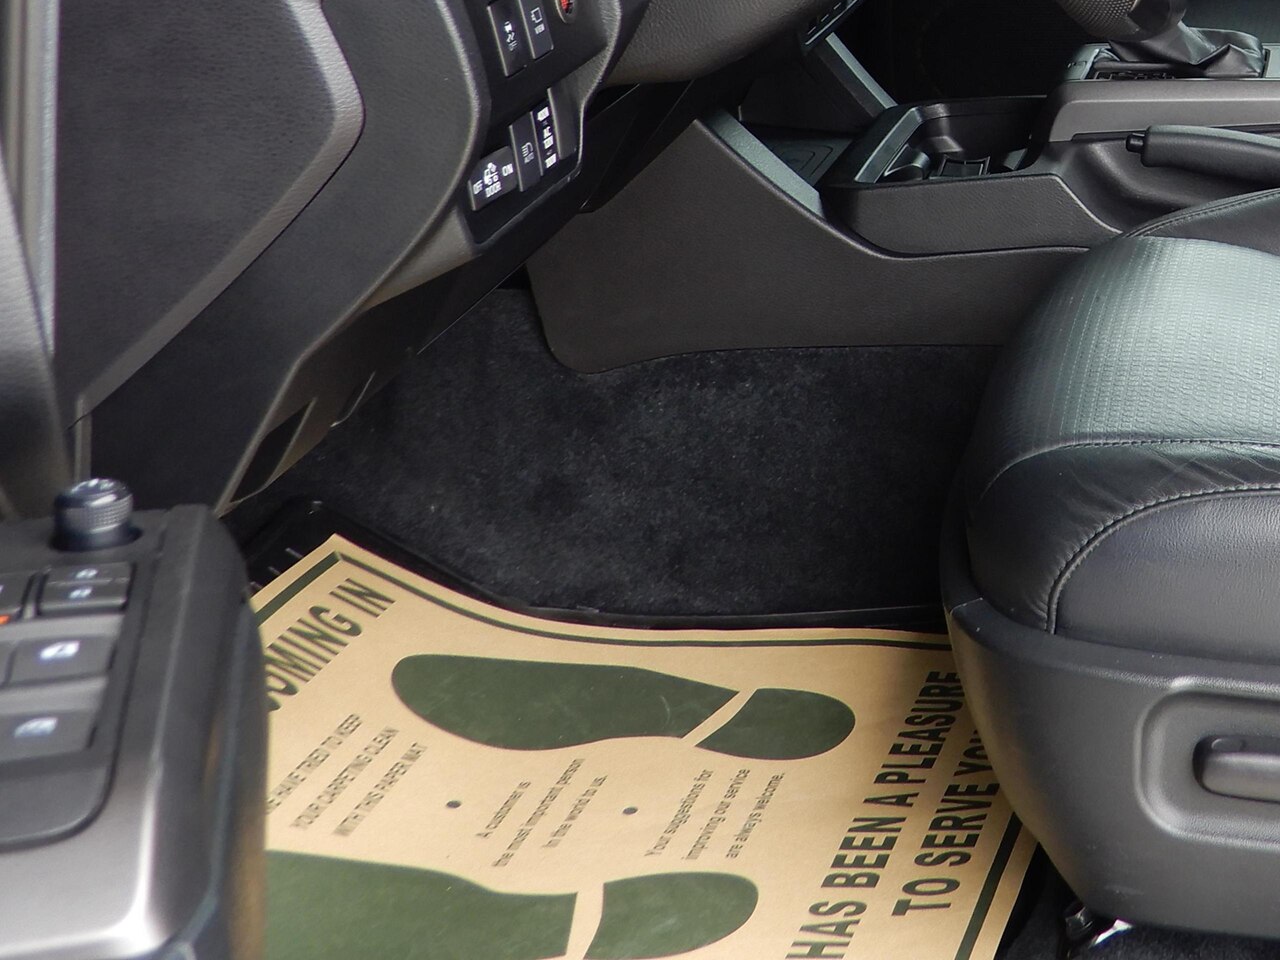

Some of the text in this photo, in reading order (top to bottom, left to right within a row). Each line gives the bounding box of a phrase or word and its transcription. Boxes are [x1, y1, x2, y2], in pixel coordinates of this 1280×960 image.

[264, 578, 396, 712] OMING IN
[271, 772, 307, 800] HAVE
[295, 747, 331, 773] TRIED
[320, 735, 343, 750] TO
[333, 713, 363, 738] KEEP
[289, 726, 400, 830] YOUR CARPETING CLEAN
[354, 790, 385, 813] THIS
[373, 761, 413, 793] PAPER
[400, 742, 428, 762] MAT
[485, 790, 525, 830] customer
[644, 769, 714, 857] Your suggestions for
[681, 768, 751, 860] improving our service
[725, 772, 786, 859] are always welcome.
[785, 670, 964, 960] HAS BEEN A PLEASURE
[891, 728, 1000, 917] TO SERVE YO
